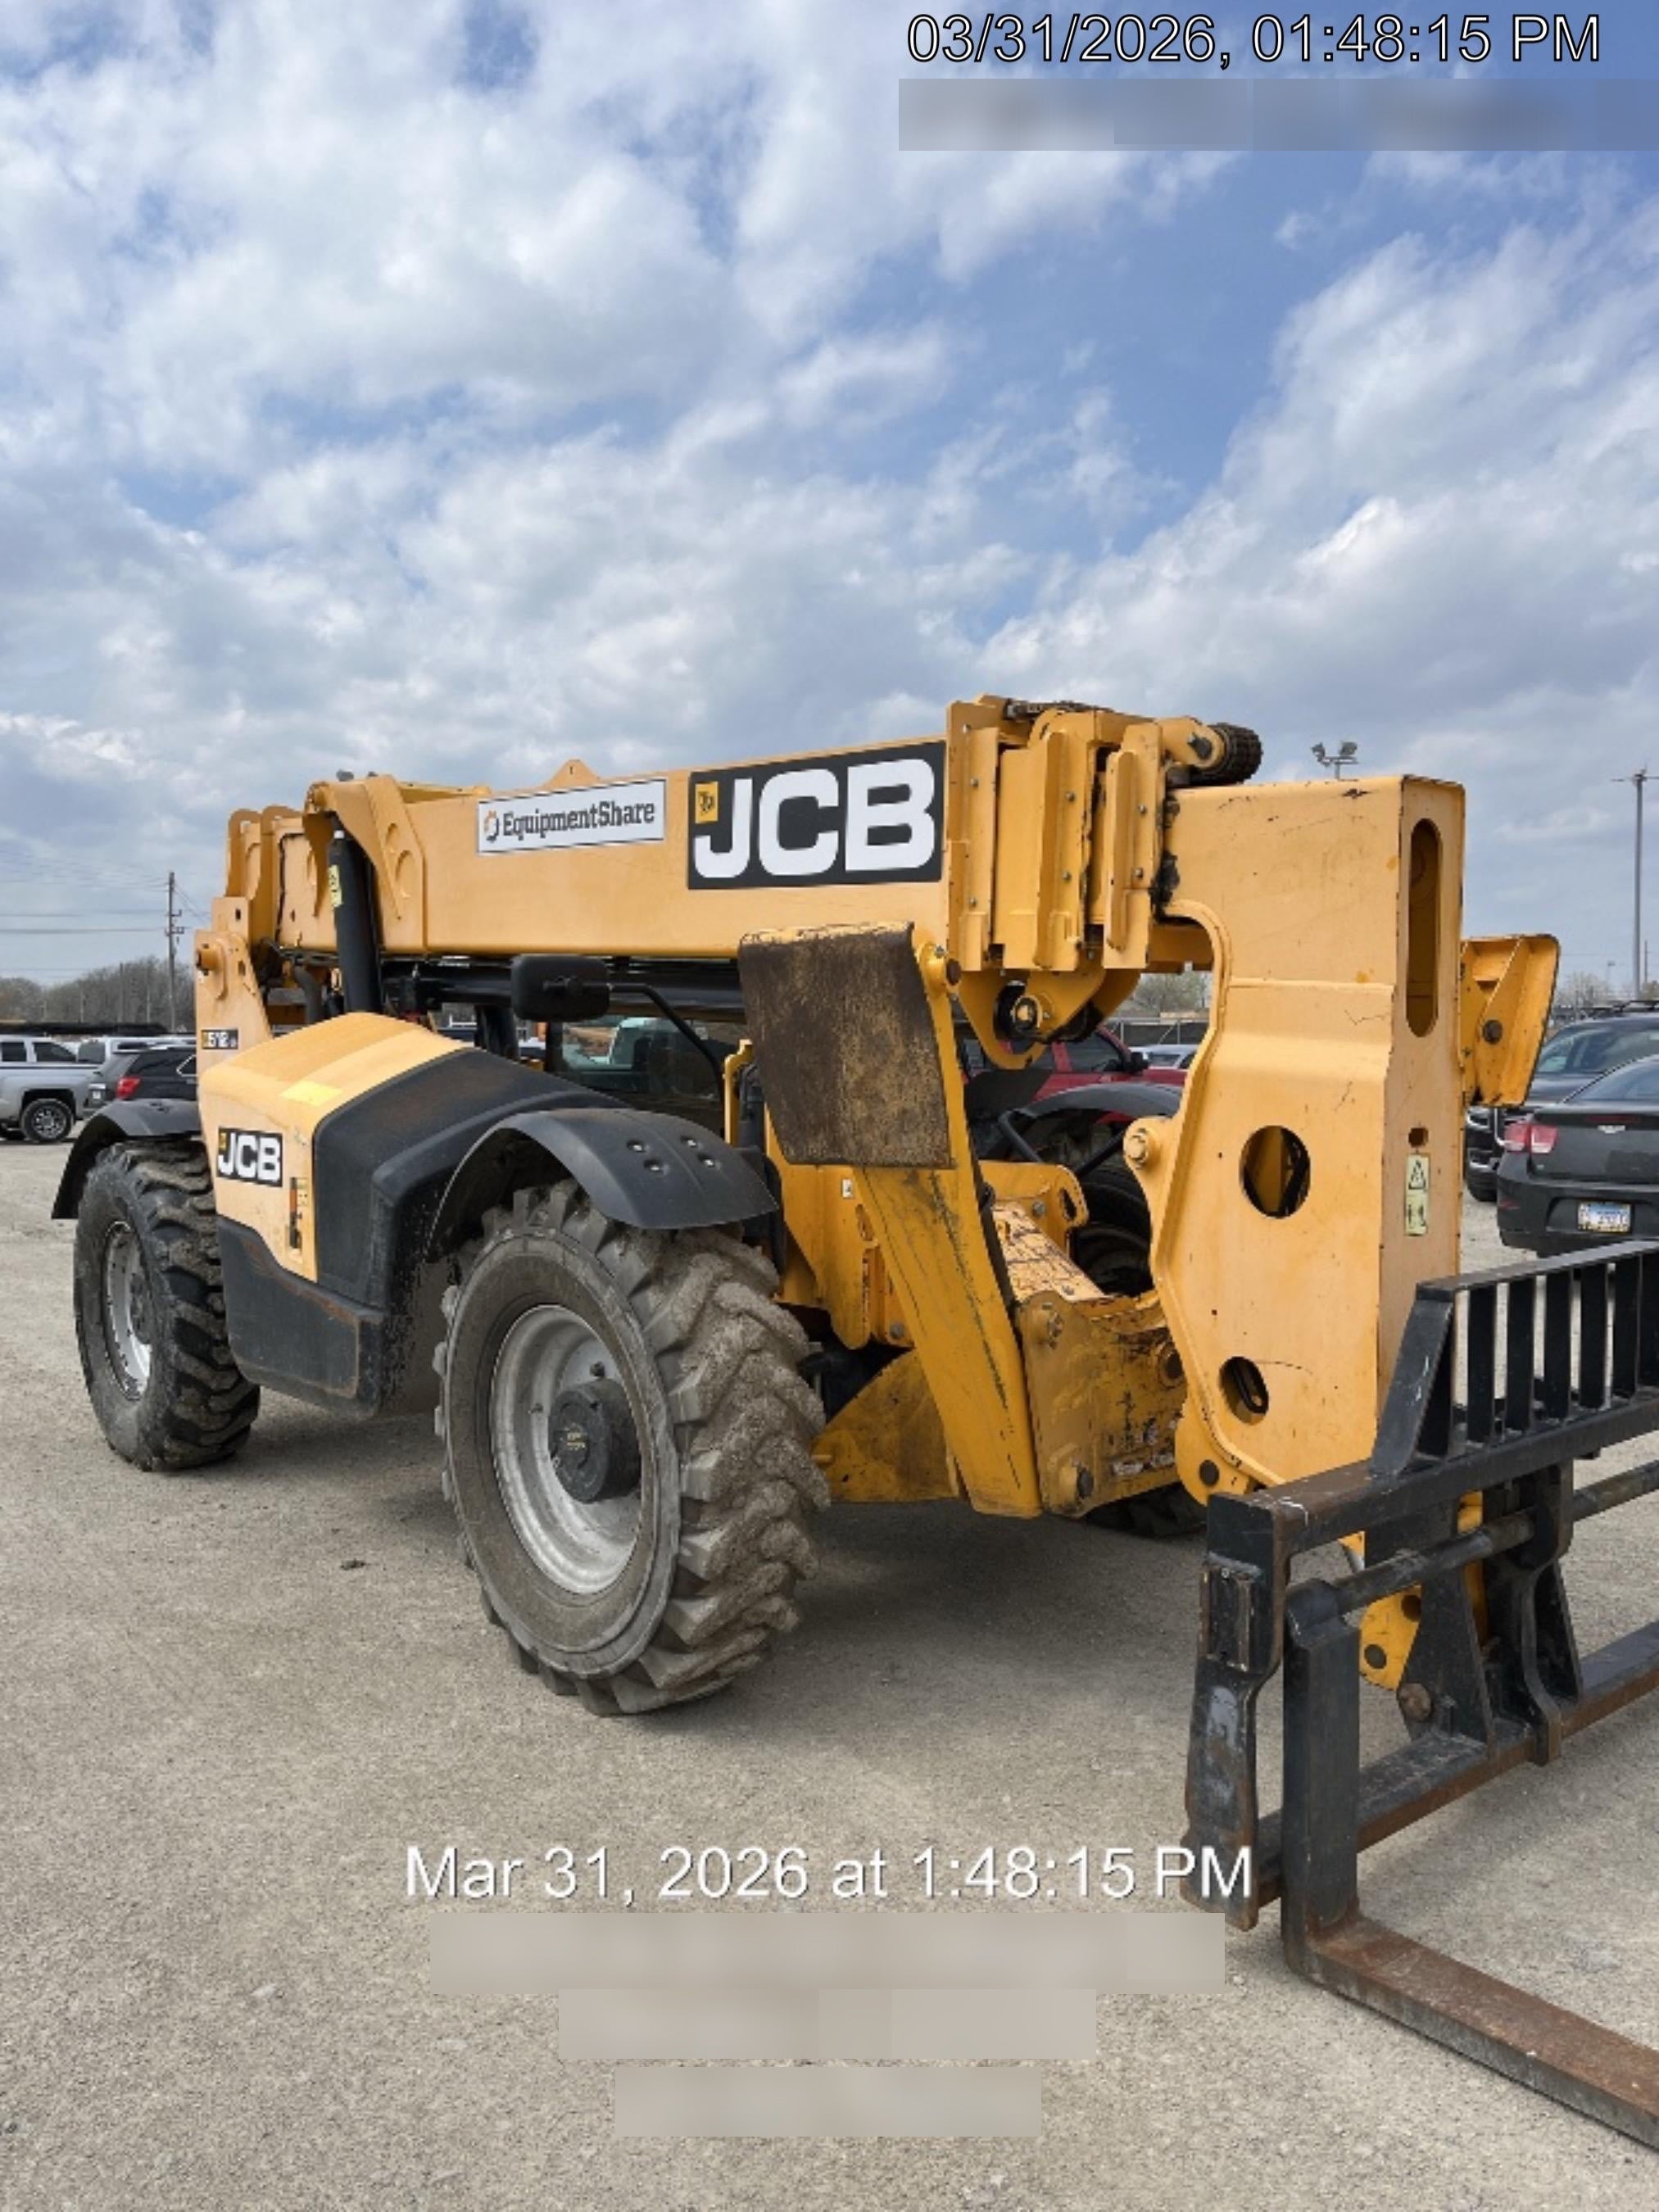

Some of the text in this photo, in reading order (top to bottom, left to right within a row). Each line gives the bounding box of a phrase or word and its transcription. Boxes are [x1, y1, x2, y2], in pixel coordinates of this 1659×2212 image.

[503, 800, 655, 841] EquipmentShare
[694, 759, 935, 879] JCB
[218, 1133, 280, 1182] JCB
